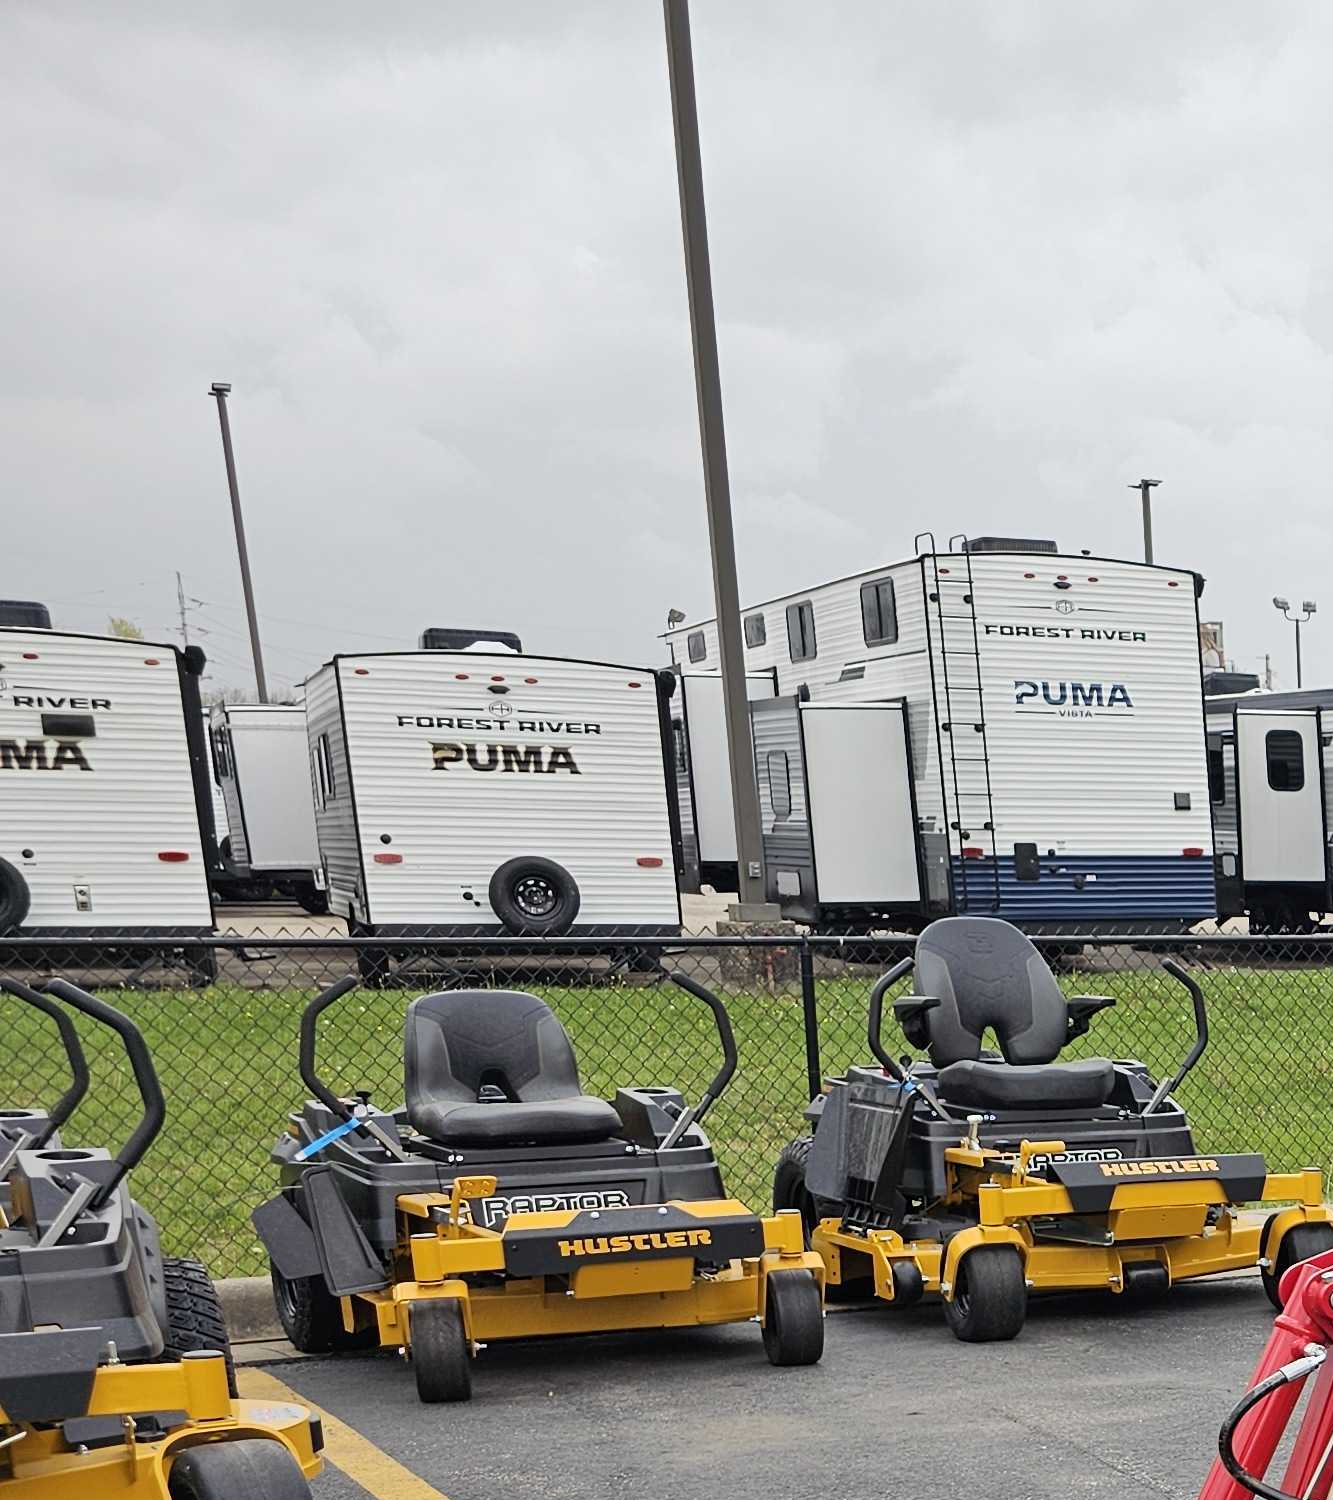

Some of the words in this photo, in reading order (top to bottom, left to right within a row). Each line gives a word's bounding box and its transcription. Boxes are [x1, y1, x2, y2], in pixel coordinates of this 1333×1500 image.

[984, 624, 1074, 639] FOREST
[1081, 628, 1147, 642] RIVER
[13, 695, 112, 710] RIVER
[1014, 680, 1134, 708] PUMA
[397, 715, 511, 731] FOREST
[518, 720, 602, 735] RIVER
[0, 740, 95, 771] MA
[428, 740, 582, 774] PUMA
[1100, 1159, 1220, 1177] HUSTLER
[558, 1229, 712, 1257] HUSTLER
